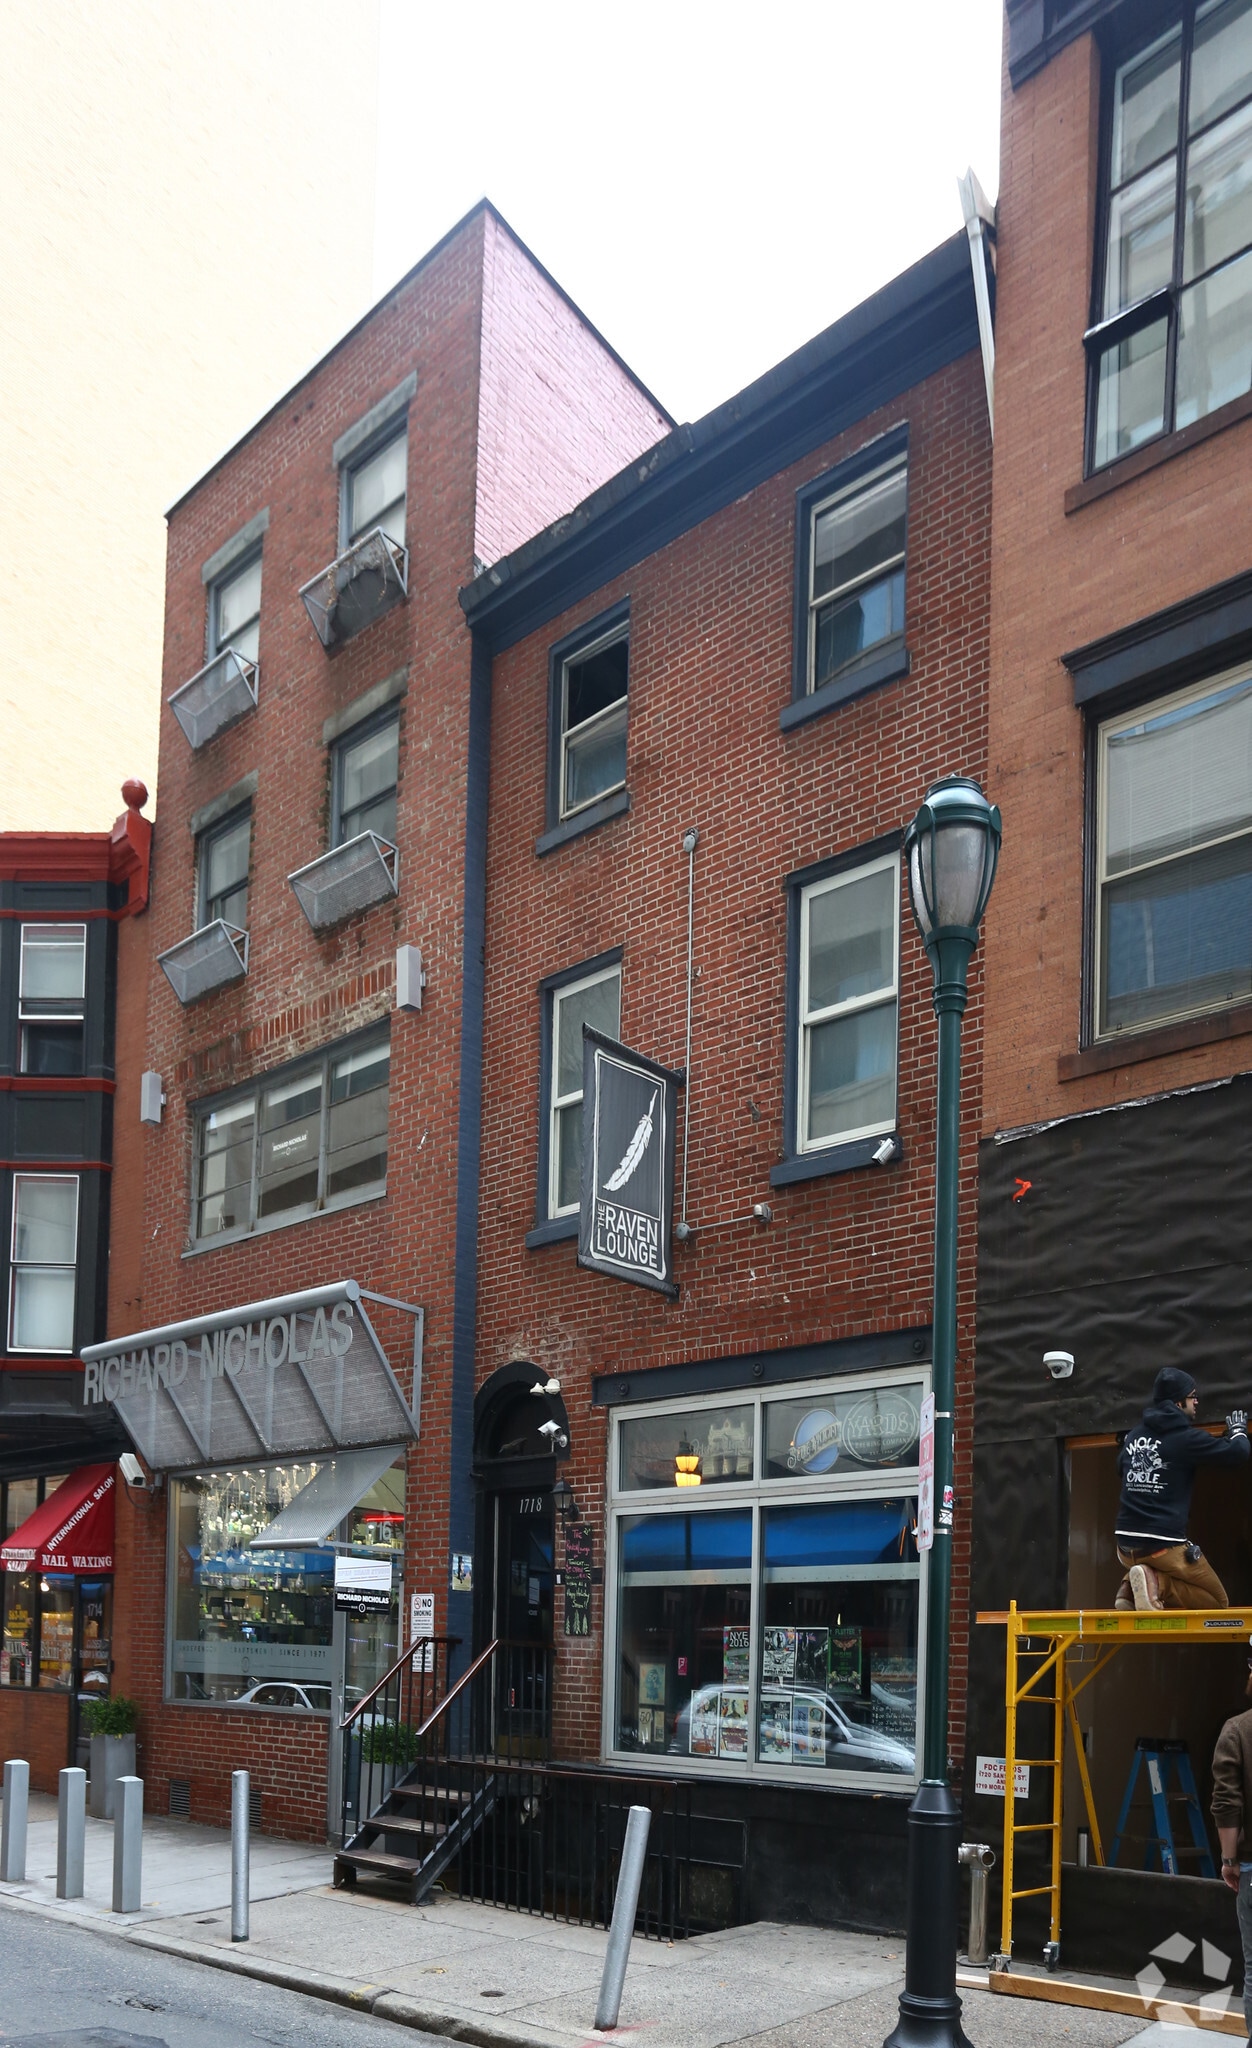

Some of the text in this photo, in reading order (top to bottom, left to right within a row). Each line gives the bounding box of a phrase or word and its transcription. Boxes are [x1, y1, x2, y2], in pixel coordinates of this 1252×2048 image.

[597, 1203, 658, 1246] THE RAVEN
[597, 1228, 658, 1269] LOUNGE
[83, 1301, 354, 1405] RICHARD NICHOLAS
[847, 1411, 910, 1438] YARDS
[1126, 1436, 1162, 1456] WOLF
[520, 1497, 542, 1514] 1718
[46, 1476, 116, 1552] INTERNATIONAL SALON
[42, 1554, 68, 1567] NAIL
[72, 1556, 112, 1568] WAXING
[336, 1592, 390, 1604] RICHARD NICHOLAS
[422, 1598, 432, 1608] NO
[88, 1603, 102, 1616] 1714
[729, 1631, 748, 1640] NYE
[729, 1640, 750, 1648] 2016
[310, 1650, 326, 1658] 1971
[999, 1765, 1022, 1773] FEDS
[988, 1784, 1018, 1792] MORAN
